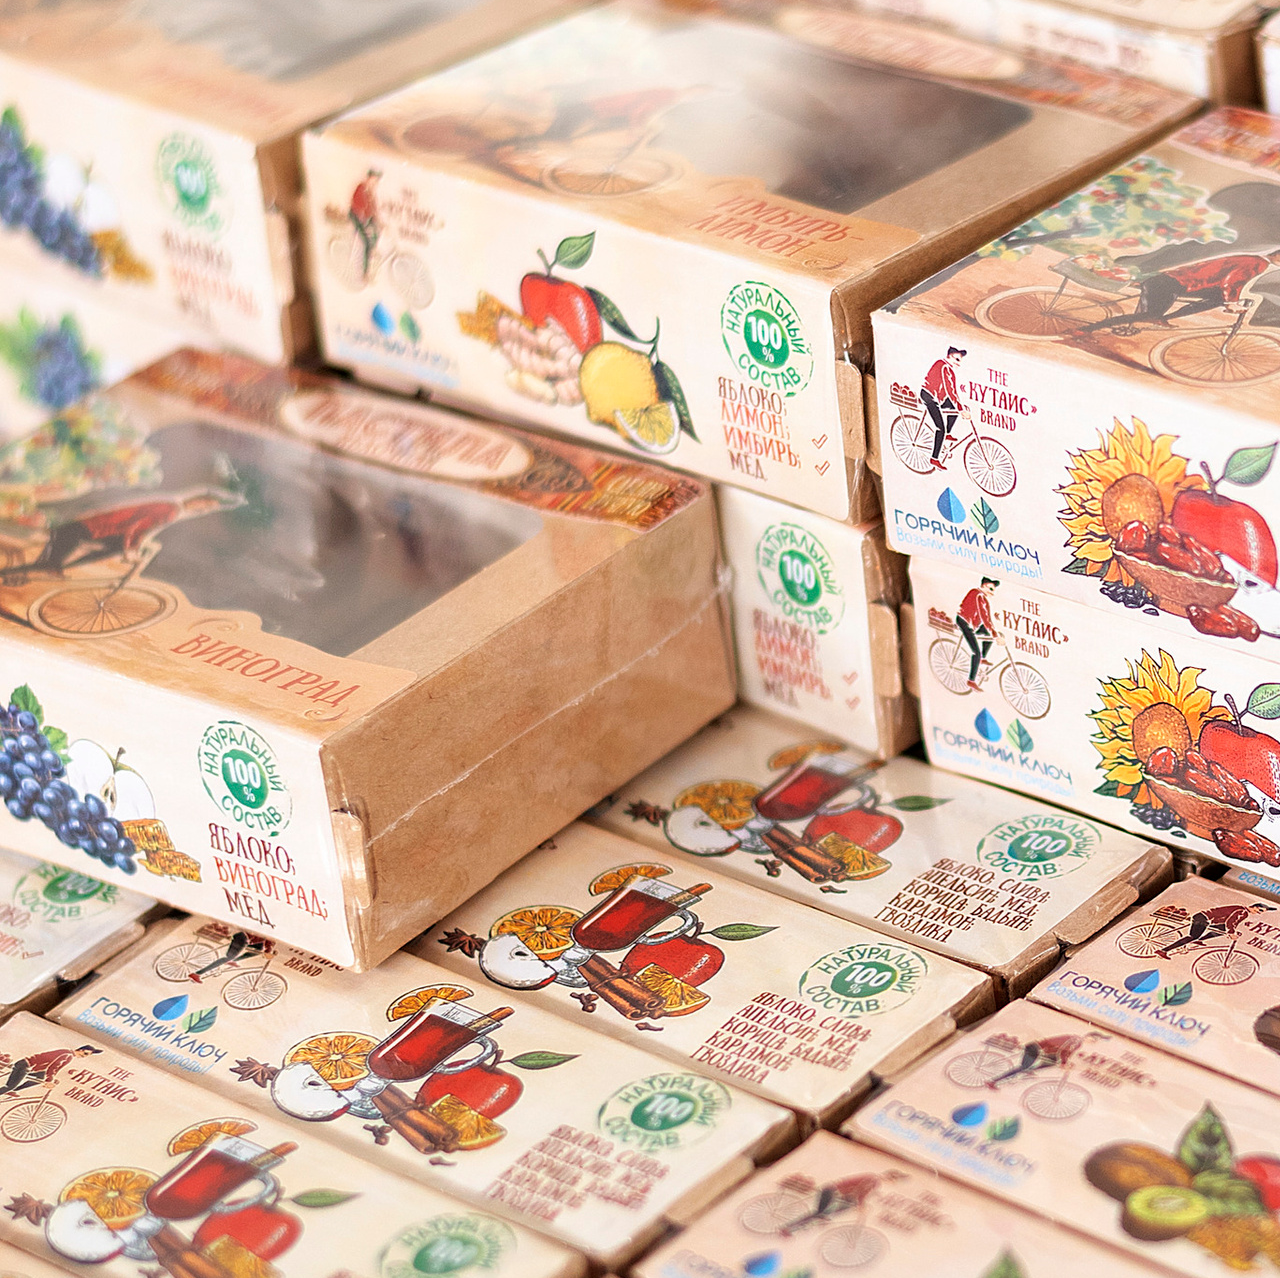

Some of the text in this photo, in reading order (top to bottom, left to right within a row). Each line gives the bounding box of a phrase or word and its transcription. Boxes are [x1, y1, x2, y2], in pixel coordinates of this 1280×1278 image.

[690, 214, 815, 257] ЛИМОН
[716, 196, 864, 242] ИМБИРЬ-
[726, 288, 813, 356] НАТУРАЛЬНЫЙ
[747, 316, 782, 347] 100
[718, 377, 786, 416] ЯБЛОКО;
[986, 368, 1009, 387] THE
[959, 381, 1037, 416] «КУТАИС»
[721, 399, 790, 439] ЛИМОН;
[980, 408, 1017, 432] BRAND
[723, 425, 801, 468] ИМБИРЬ;
[894, 508, 1041, 565] ГОРЯЧИЙ КЛЮЧ
[896, 525, 1043, 580] Возьми силу природы!
[762, 529, 842, 595] НАТУРАЛЬНЫЙ
[783, 556, 815, 589] 100
[1020, 598, 1041, 616] THE
[994, 610, 1069, 645] «КУТАИС»
[1014, 636, 1050, 658] BRAND
[170, 634, 361, 707] ВИНОГРАД
[205, 728, 289, 792] НАТУРАЛЬНЫЙ
[224, 757, 261, 789] 100
[933, 726, 1015, 765] ГОРЯЧИЙ
[1018, 752, 1073, 785] КЛЮЧ
[208, 823, 296, 875] ЯБЛОКО;
[995, 816, 1096, 859] НАТУРАЛЬНЫЙ
[1022, 833, 1066, 853] 100
[213, 856, 328, 921] ВИНОГРАД;
[917, 869, 999, 903] АПЕЛЬСИН;
[932, 858, 1050, 903] ЯБЛОКО; СЛИВА;
[875, 906, 954, 943] ГВОЗДИКА
[888, 893, 974, 931] КАРДАМОН;
[903, 880, 1033, 931] КОРИЦА; БАДЬЯН;
[284, 956, 323, 978] BRAND
[818, 947, 920, 994] НАТУРАЛЬНЫЙ
[845, 965, 891, 987] 100
[1046, 980, 1096, 1012] Возьми
[1059, 970, 1212, 1037] ГОРЯЧИЙ КЛЮЧ
[77, 1009, 215, 1076] Возьми силу природы!
[91, 997, 229, 1064] ГОРЯЧИЙ КЛЮЧ
[108, 1066, 134, 1082] THE
[690, 1046, 769, 1084] ГВОЗДИКА
[64, 1086, 105, 1108] BRAND
